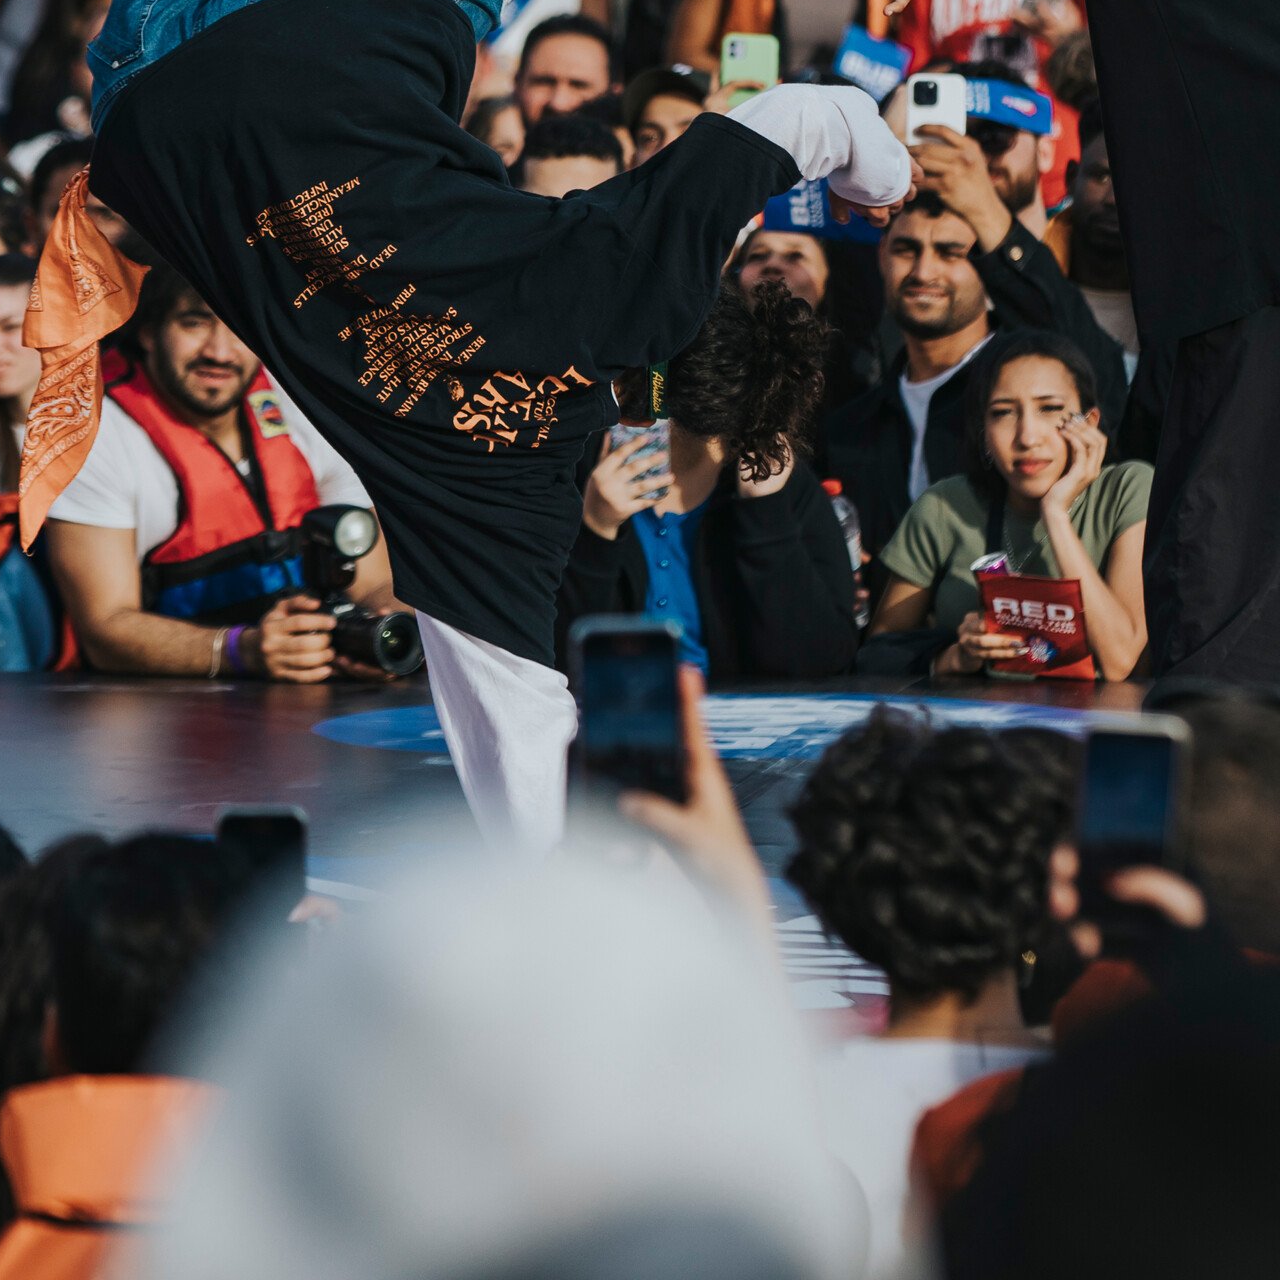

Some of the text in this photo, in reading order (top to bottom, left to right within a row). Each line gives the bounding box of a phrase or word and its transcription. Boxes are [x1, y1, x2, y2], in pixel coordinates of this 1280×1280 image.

[368, 243, 396, 269] DEAD
[382, 330, 398, 346] OF
[419, 322, 451, 348] MASS
[363, 341, 384, 362] PAIN
[375, 375, 402, 403] HATE
[992, 597, 1075, 622] RED
